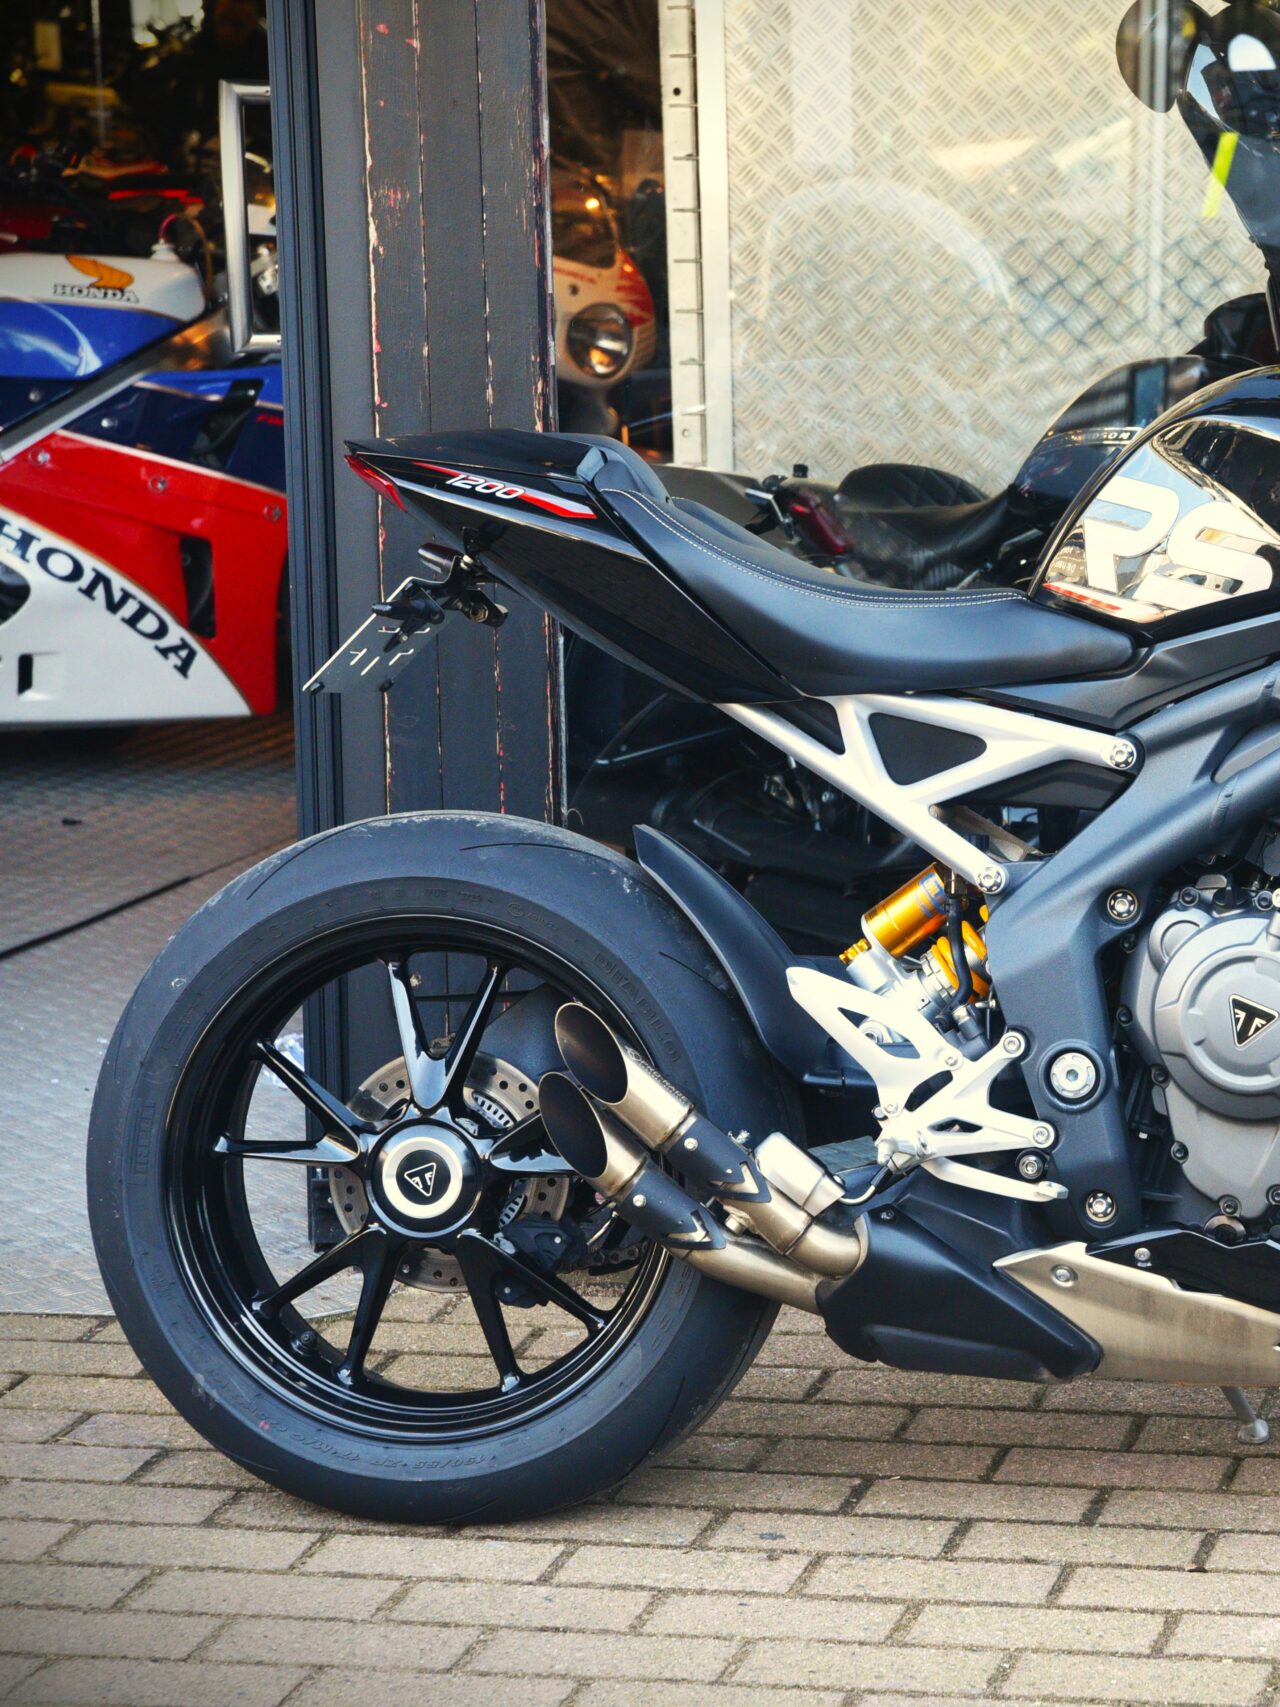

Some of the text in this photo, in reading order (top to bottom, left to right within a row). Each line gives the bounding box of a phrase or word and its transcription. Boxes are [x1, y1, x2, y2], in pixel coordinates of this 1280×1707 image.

[53, 283, 139, 304] HONDA
[445, 474, 525, 499] 1200
[0, 517, 198, 679] HONDA
